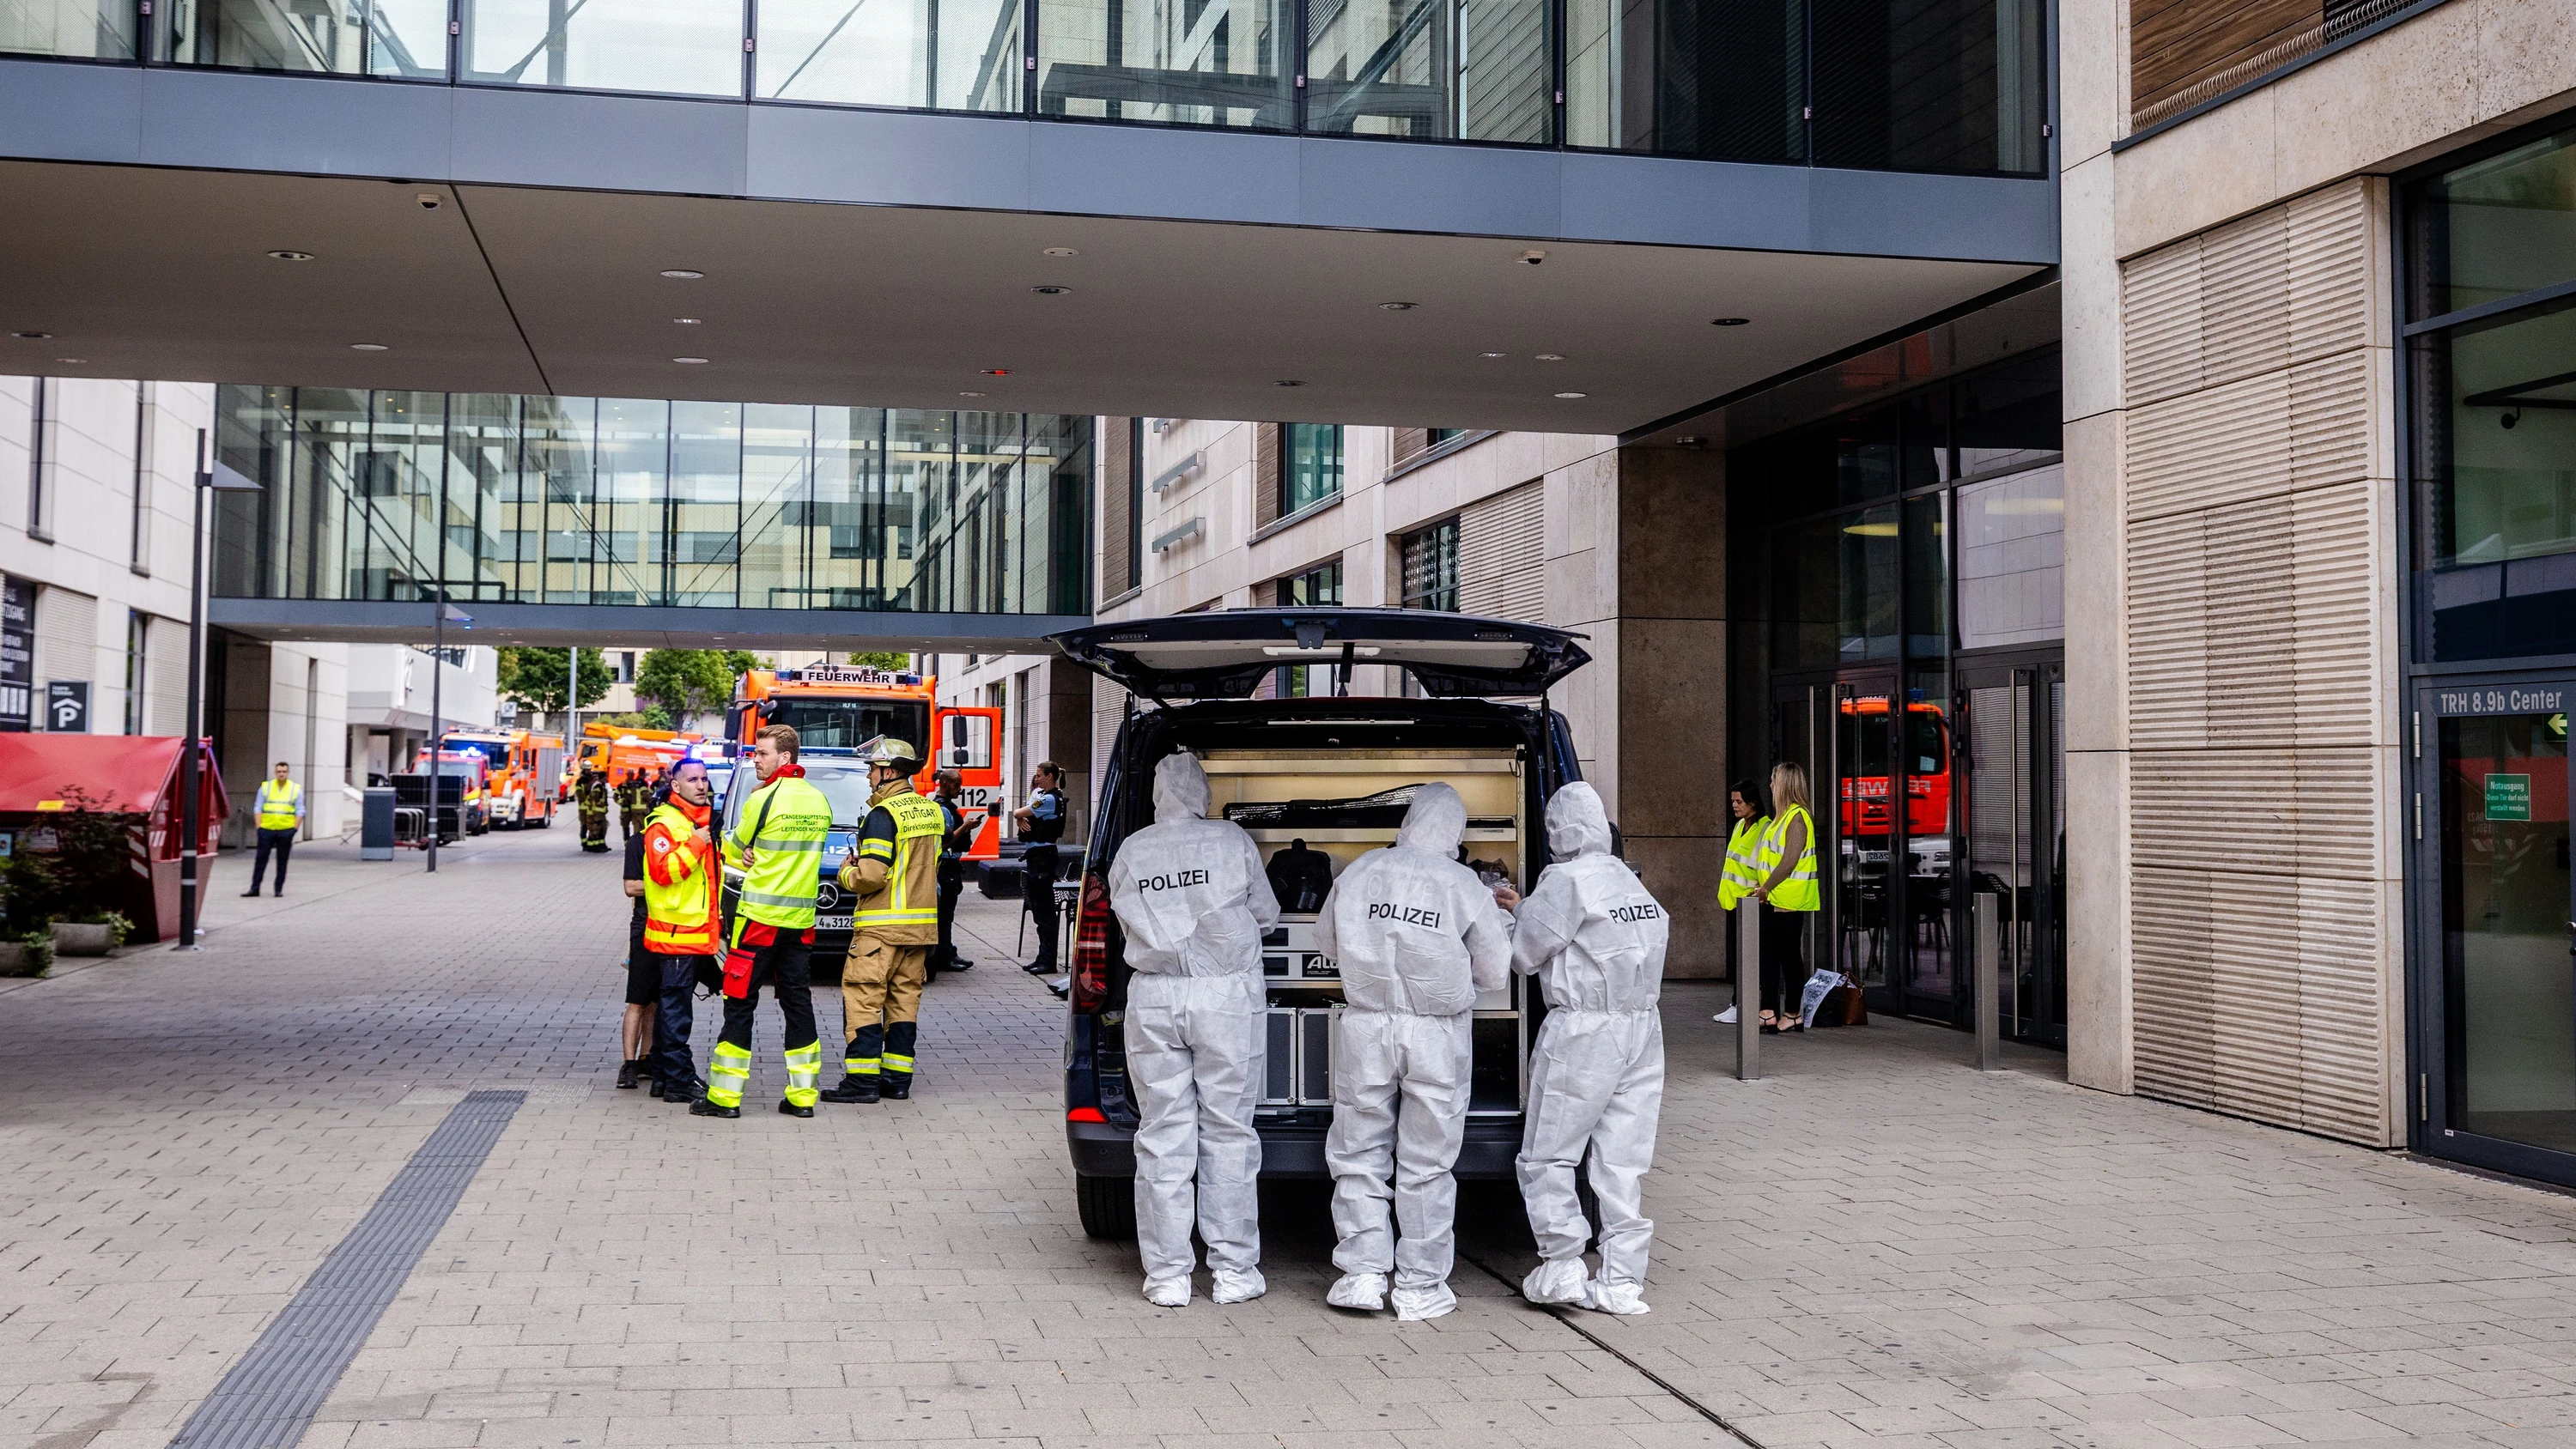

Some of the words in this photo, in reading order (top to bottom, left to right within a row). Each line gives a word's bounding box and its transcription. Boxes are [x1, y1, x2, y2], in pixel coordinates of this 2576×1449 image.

[808, 671, 890, 683] FEUERWEHR
[2440, 693, 2468, 713] TRH
[2472, 691, 2506, 712] 8.9b
[2510, 689, 2562, 711] Center
[58, 706, 78, 729] P
[2490, 781, 2524, 792] Notausgang
[889, 796, 933, 809] FEUERWEHR
[958, 788, 987, 807] 112
[1138, 870, 1209, 894] POLIZEI
[818, 917, 825, 928] 4
[831, 917, 854, 928] 3128
[1368, 903, 1441, 929] POLIZEI
[1608, 904, 1661, 924] POIZEI
